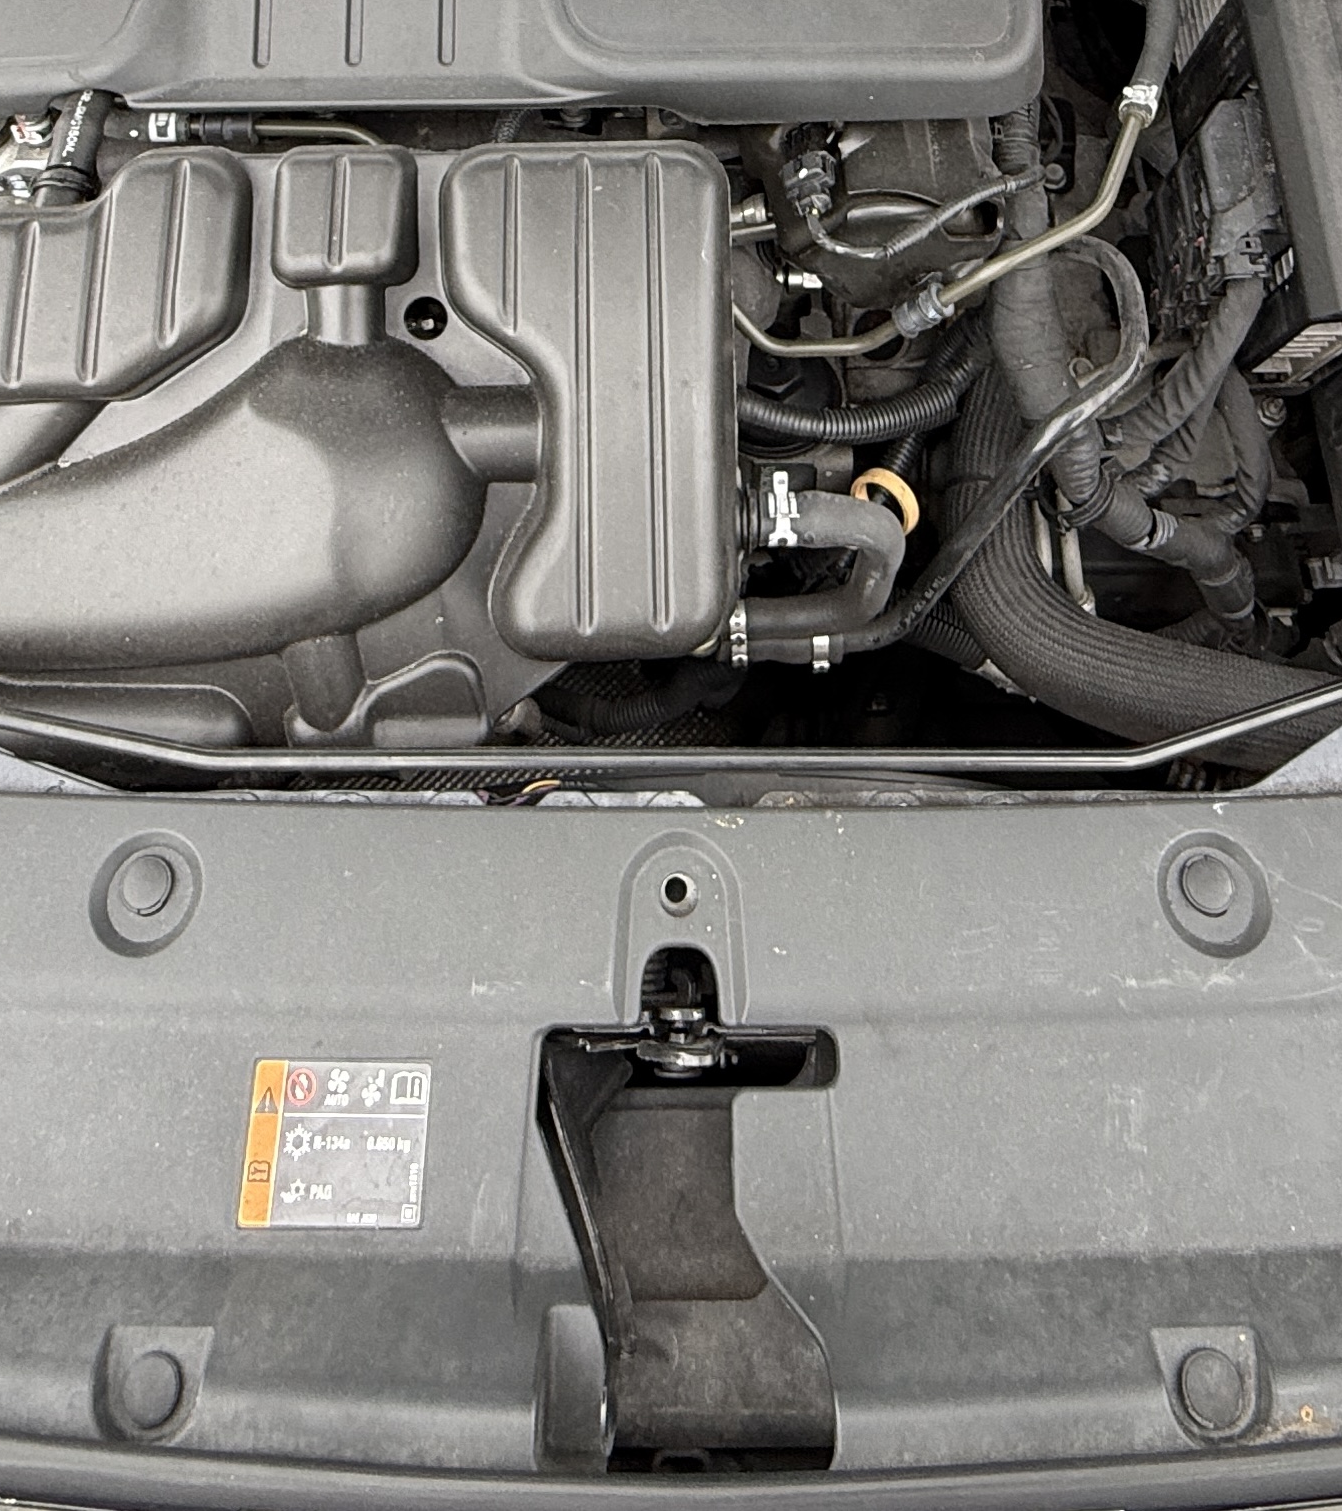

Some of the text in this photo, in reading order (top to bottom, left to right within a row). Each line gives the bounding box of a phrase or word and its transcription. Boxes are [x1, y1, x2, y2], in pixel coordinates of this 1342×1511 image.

[323, 1093, 349, 1106] AUTO
[313, 1135, 351, 1150] R-134a
[397, 1136, 411, 1154] kg
[309, 1184, 333, 1200] PAG
